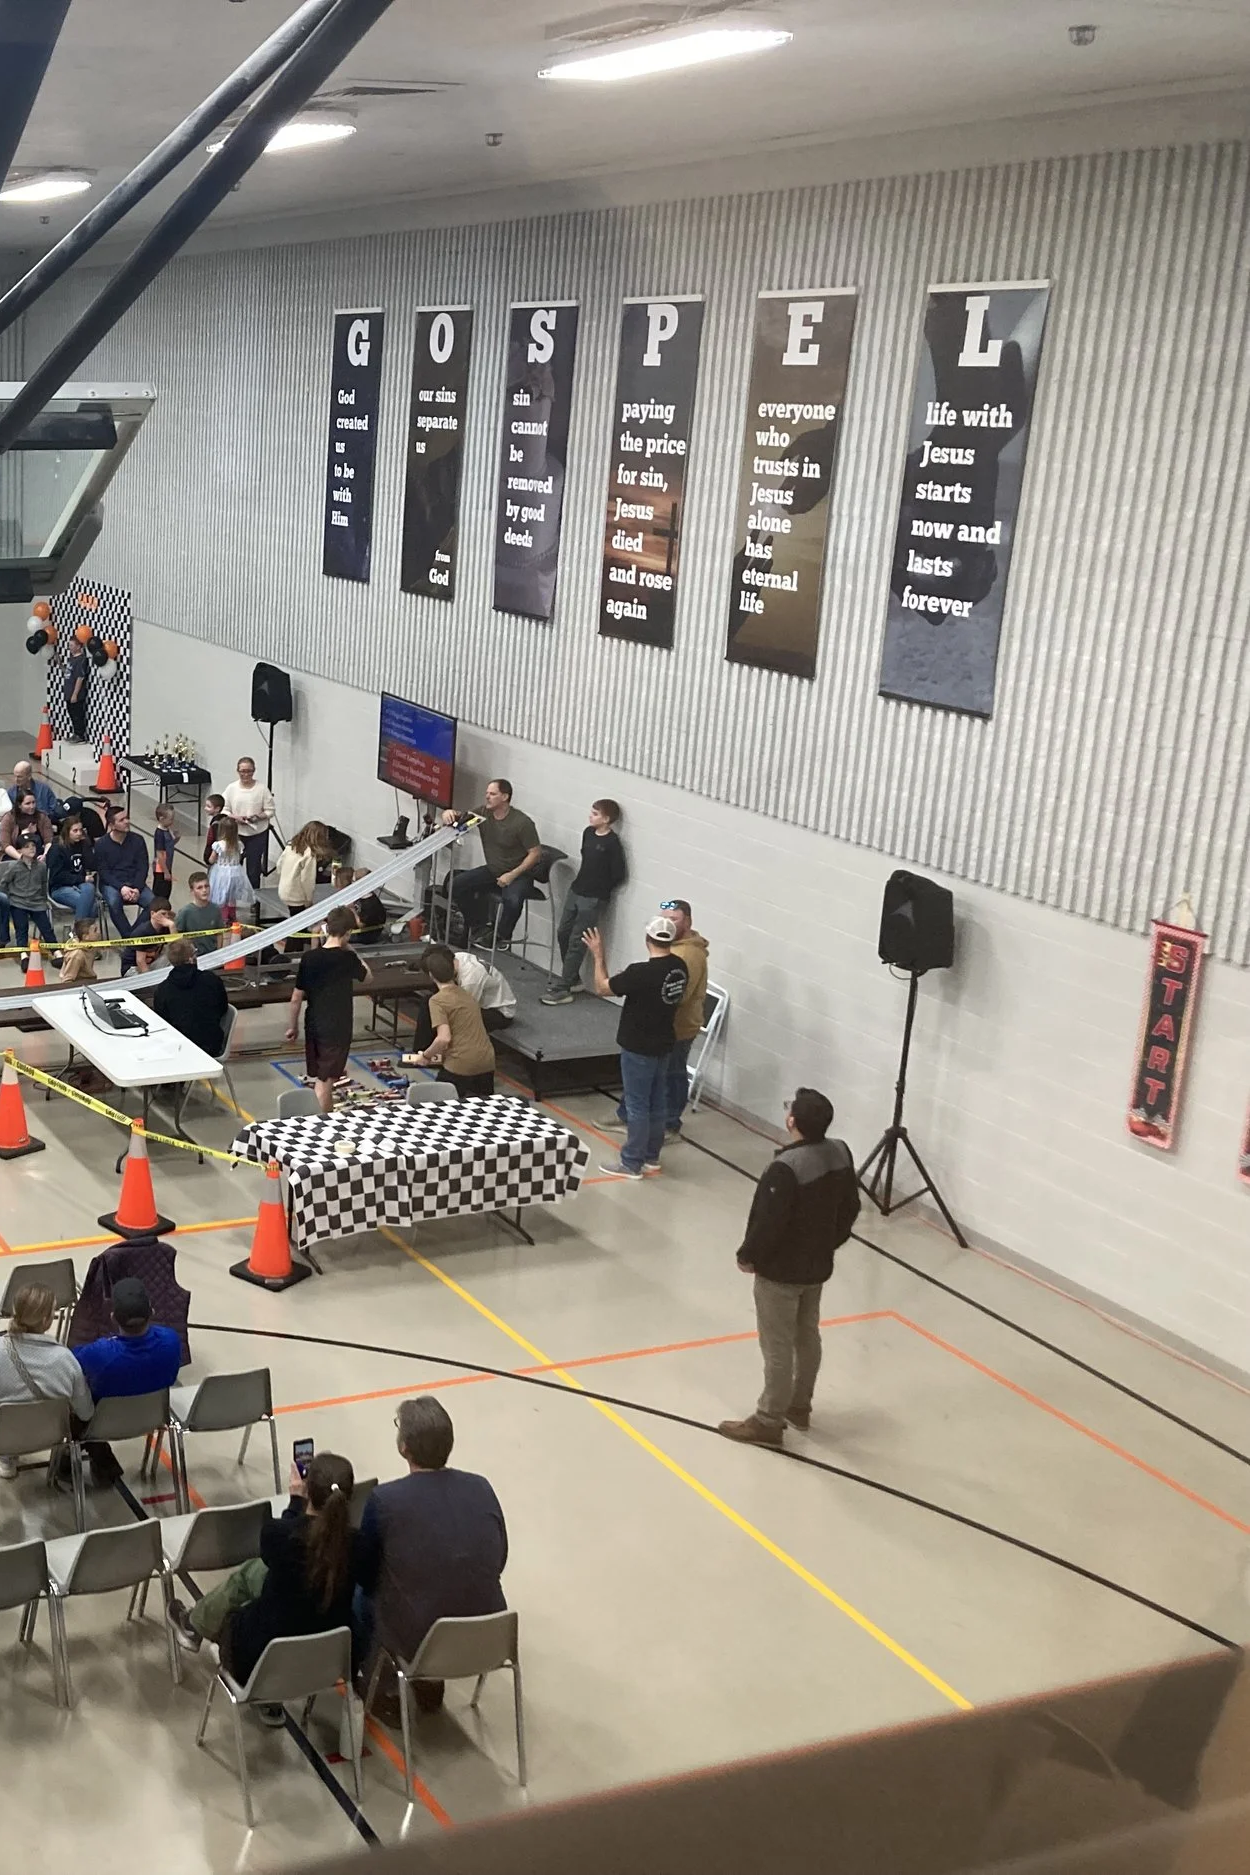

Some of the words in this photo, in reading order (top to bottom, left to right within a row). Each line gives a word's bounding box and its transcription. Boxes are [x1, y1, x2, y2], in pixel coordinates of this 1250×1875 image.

[347, 319, 371, 367] G
[429, 312, 455, 364] O
[527, 309, 557, 364] S
[642, 303, 679, 367] P
[781, 301, 825, 366] E
[957, 295, 1004, 367] L
[337, 388, 356, 405] God
[418, 390, 435, 402] our
[434, 385, 457, 404] sins
[512, 388, 531, 407] sin
[336, 414, 369, 431] created
[621, 398, 676, 425] paying
[757, 402, 836, 425] everyone
[924, 401, 957, 427] life
[961, 403, 1013, 428] with
[416, 415, 458, 433] separate
[510, 420, 548, 437] cannot
[335, 441, 346, 454] us
[415, 441, 426, 454] us
[619, 430, 643, 453] the
[644, 432, 687, 458] price
[755, 425, 790, 448] who
[509, 443, 524, 463] be
[919, 440, 976, 468] Jesus
[334, 463, 343, 478] to
[342, 462, 355, 479] be
[616, 463, 638, 486] for
[639, 465, 669, 493] sin,
[753, 455, 800, 477] trusts
[801, 456, 821, 479] in
[332, 486, 352, 503] with
[507, 475, 554, 495] removed
[749, 482, 794, 507] Jesus
[915, 480, 972, 504] starts
[331, 510, 349, 527] Him
[505, 499, 521, 522] by
[520, 503, 546, 523] good
[613, 497, 655, 522] Jesus
[747, 509, 792, 534] alone
[503, 526, 534, 548] deeds
[611, 529, 644, 553] died
[910, 519, 955, 540] now
[957, 520, 1003, 545] and
[744, 535, 773, 560] has
[906, 549, 954, 578] lasts
[428, 567, 450, 586] God
[608, 564, 637, 585] and
[638, 571, 673, 591] rose
[741, 567, 799, 592] eternal
[606, 597, 647, 620] again
[738, 590, 765, 615] life
[901, 584, 973, 618] forever
[1144, 944, 1189, 1105] START
